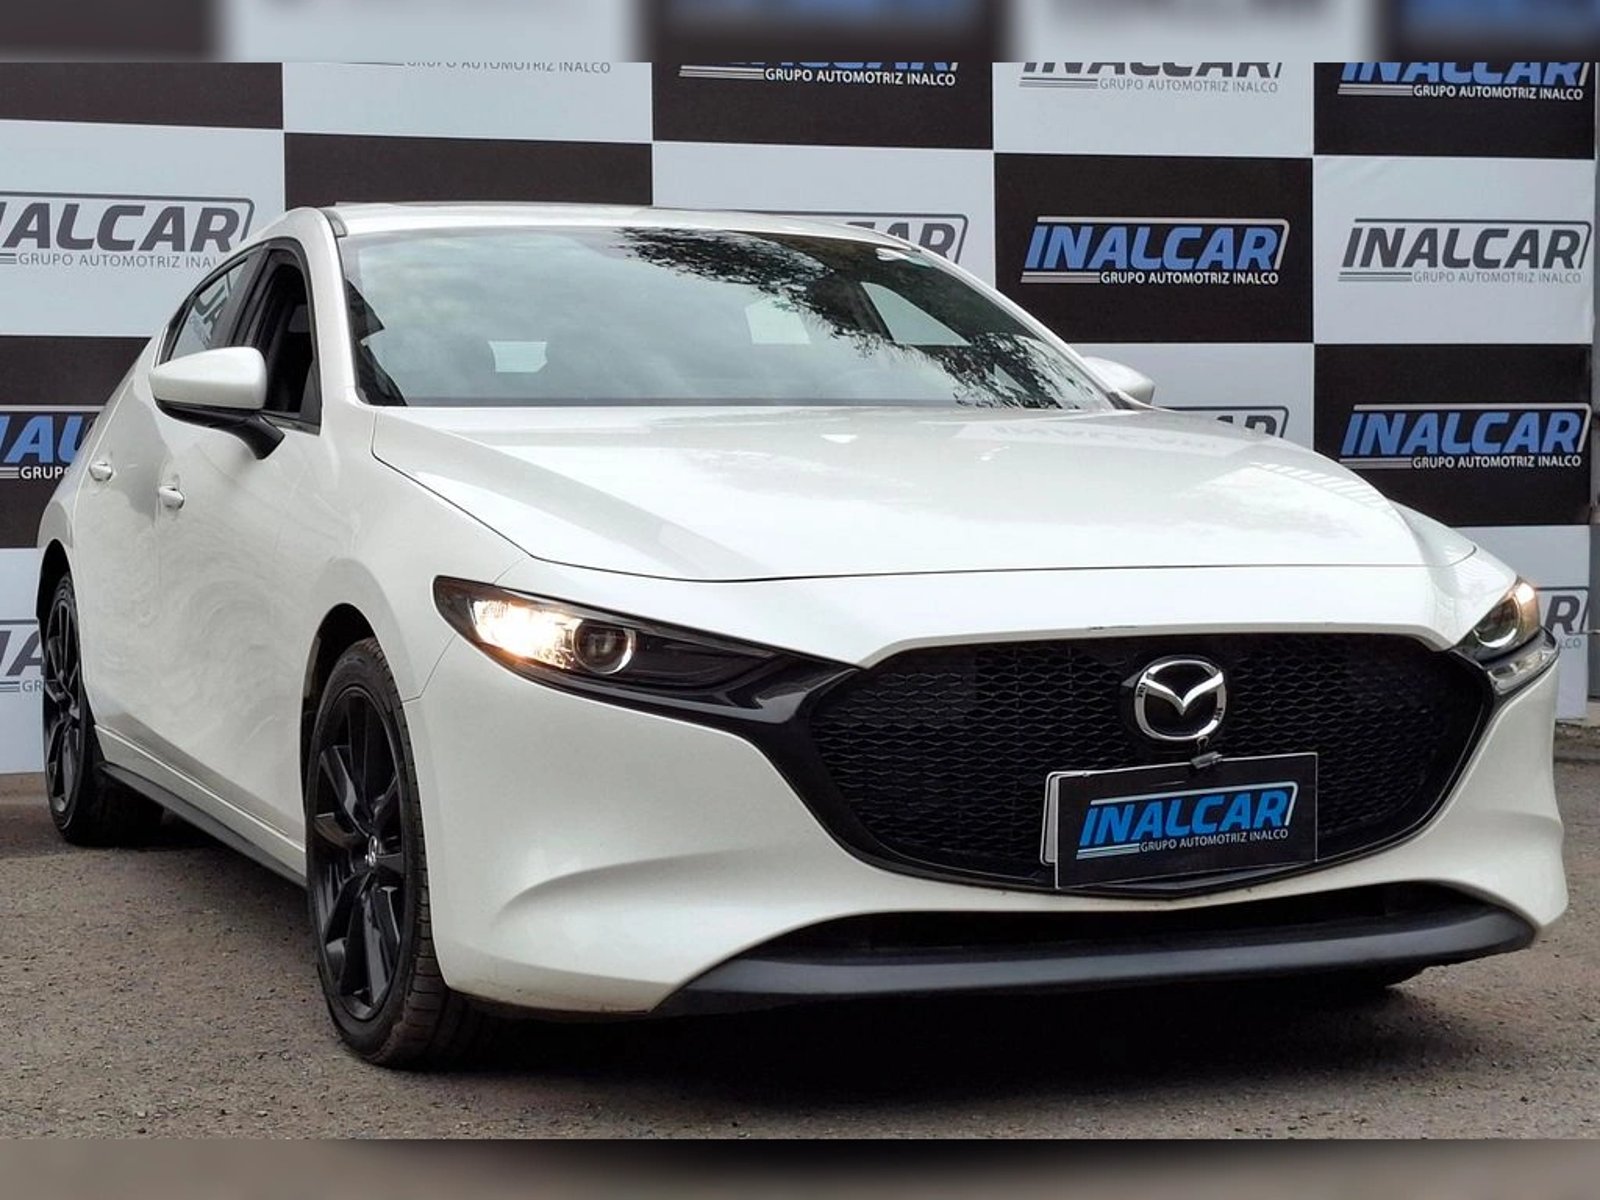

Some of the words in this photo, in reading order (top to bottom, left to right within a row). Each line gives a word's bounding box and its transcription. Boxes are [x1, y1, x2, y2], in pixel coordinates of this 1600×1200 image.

[765, 68, 814, 81] GRUPO
[816, 69, 903, 84] AUTOMOTRIZ
[907, 72, 956, 86] INALCO
[1100, 79, 1143, 90] GRUPO
[1148, 80, 1229, 92] AUTOMOTRIZ
[1232, 81, 1279, 93] INALCO
[1413, 85, 1455, 97] GRUPO
[1459, 86, 1537, 99] AUTOMOTRIZ
[1540, 87, 1584, 100] INALCO
[0, 202, 240, 252] ALCAR
[1024, 225, 1279, 271] INALCAR
[1341, 227, 1581, 269] INALCAR
[18, 252, 73, 265] GRUPO
[79, 254, 180, 268] AUTOMOTRIZ
[1101, 271, 1145, 284] GRUPO
[1148, 272, 1230, 284] AUTOMOTRIZ
[1233, 272, 1279, 284] INALCO
[1413, 271, 1454, 283] GRUPO
[1459, 272, 1535, 283] AUTOMOTRIZ
[1539, 272, 1581, 284] INALCO
[1341, 411, 1581, 456] INALCAR
[1413, 456, 1454, 469] GRUPO
[1458, 456, 1535, 468] AUTOMOTRIZ
[1538, 455, 1582, 467] INALCO
[1079, 789, 1288, 847] INALCAR
[1140, 840, 1177, 853] GRUPO
[1179, 832, 1247, 848] AUTOMOTRIZ
[1250, 829, 1289, 842] INALCO
